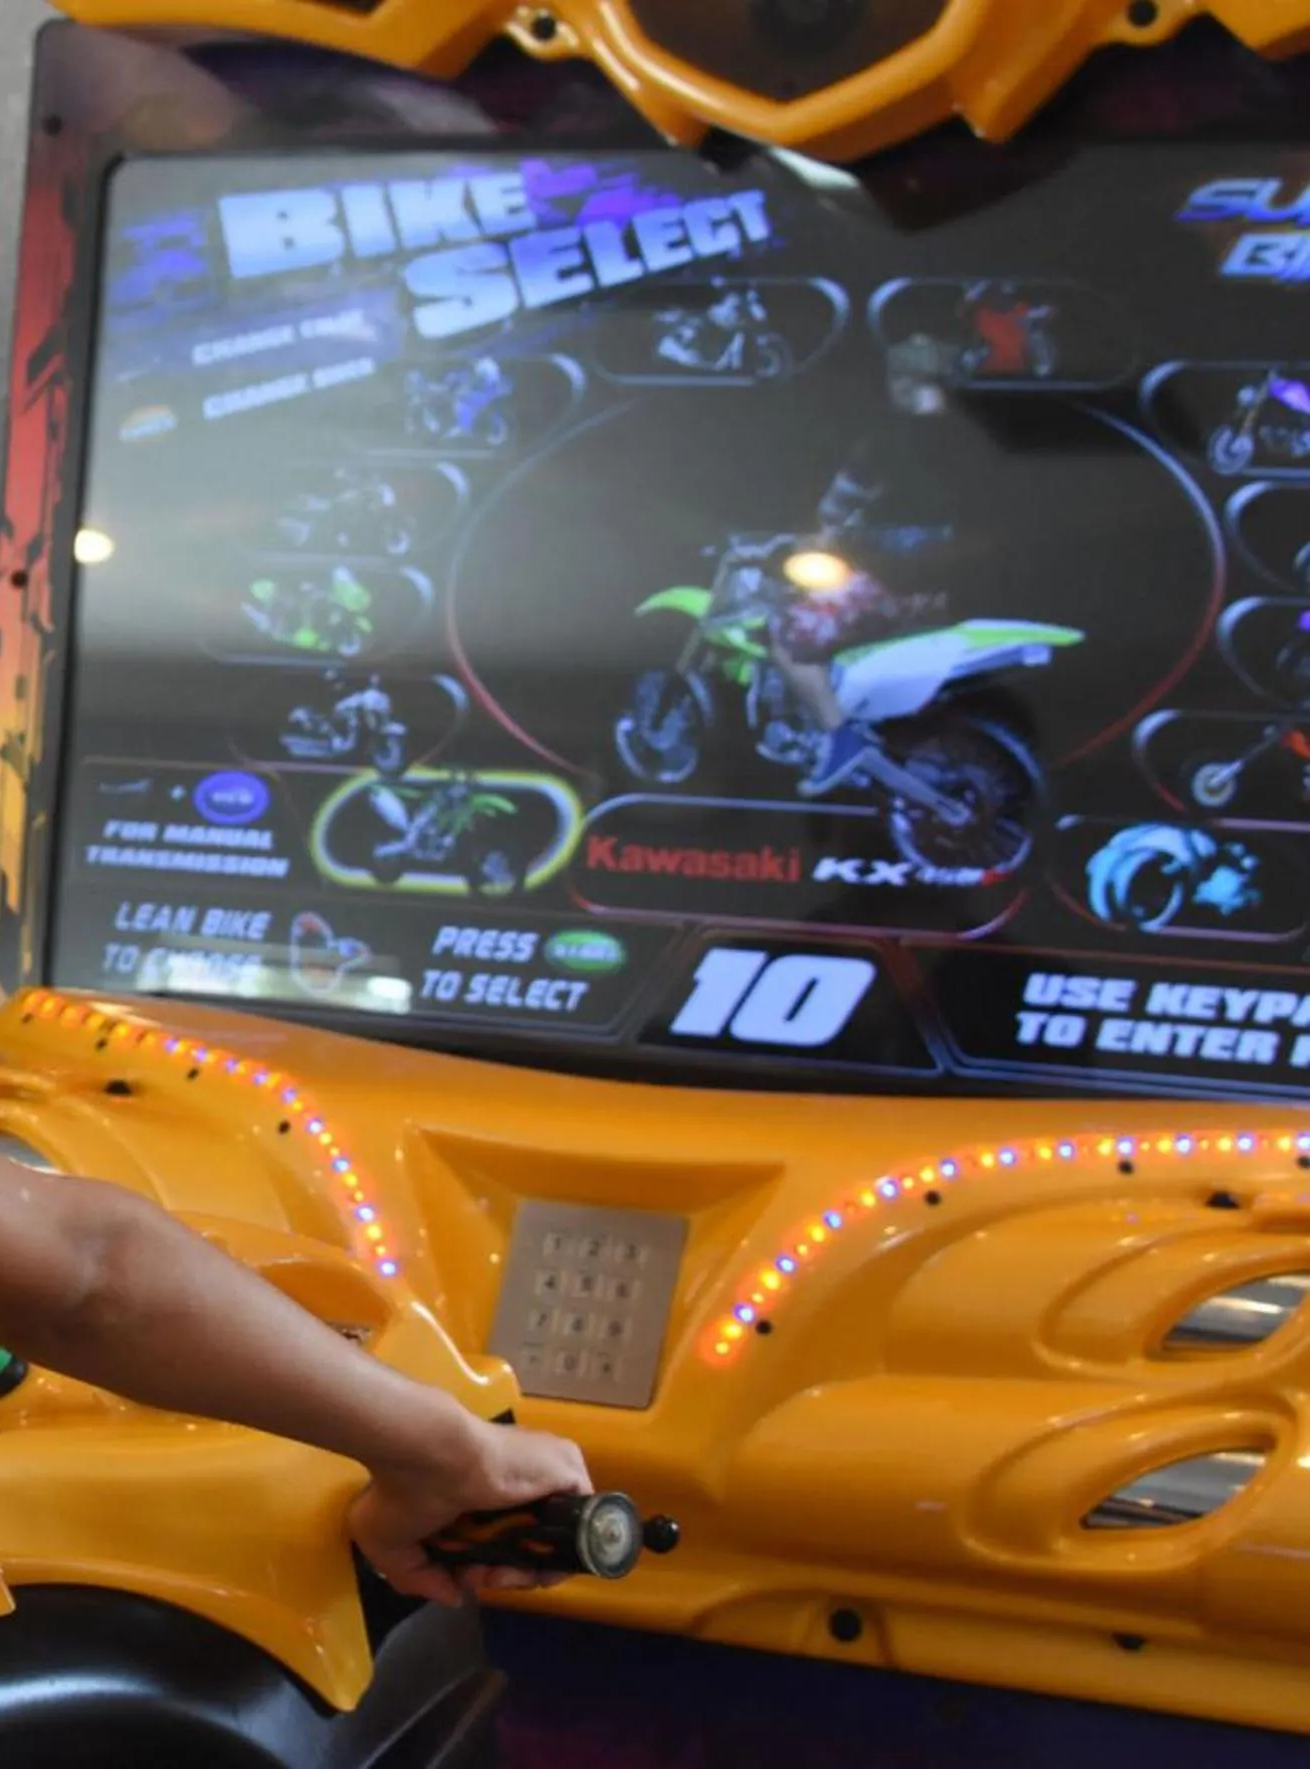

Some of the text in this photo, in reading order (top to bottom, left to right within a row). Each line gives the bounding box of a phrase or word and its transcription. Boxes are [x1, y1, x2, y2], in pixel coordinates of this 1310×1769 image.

[218, 173, 537, 279] BIKE
[403, 189, 770, 340] SELECT
[102, 819, 274, 850] FOR MANUAL
[86, 844, 290, 878] TRANSMISSION
[587, 835, 800, 883] Kawasaki
[812, 856, 915, 887] KX
[114, 901, 273, 941] LEAN BIKE
[103, 942, 139, 973] TO
[431, 925, 539, 963] PRESS
[419, 968, 589, 1012] TO SELECT
[670, 946, 876, 1047] 10
[1023, 971, 1137, 1012] USE
[1016, 1010, 1087, 1047] TO
[1095, 1018, 1280, 1064] ENTER
